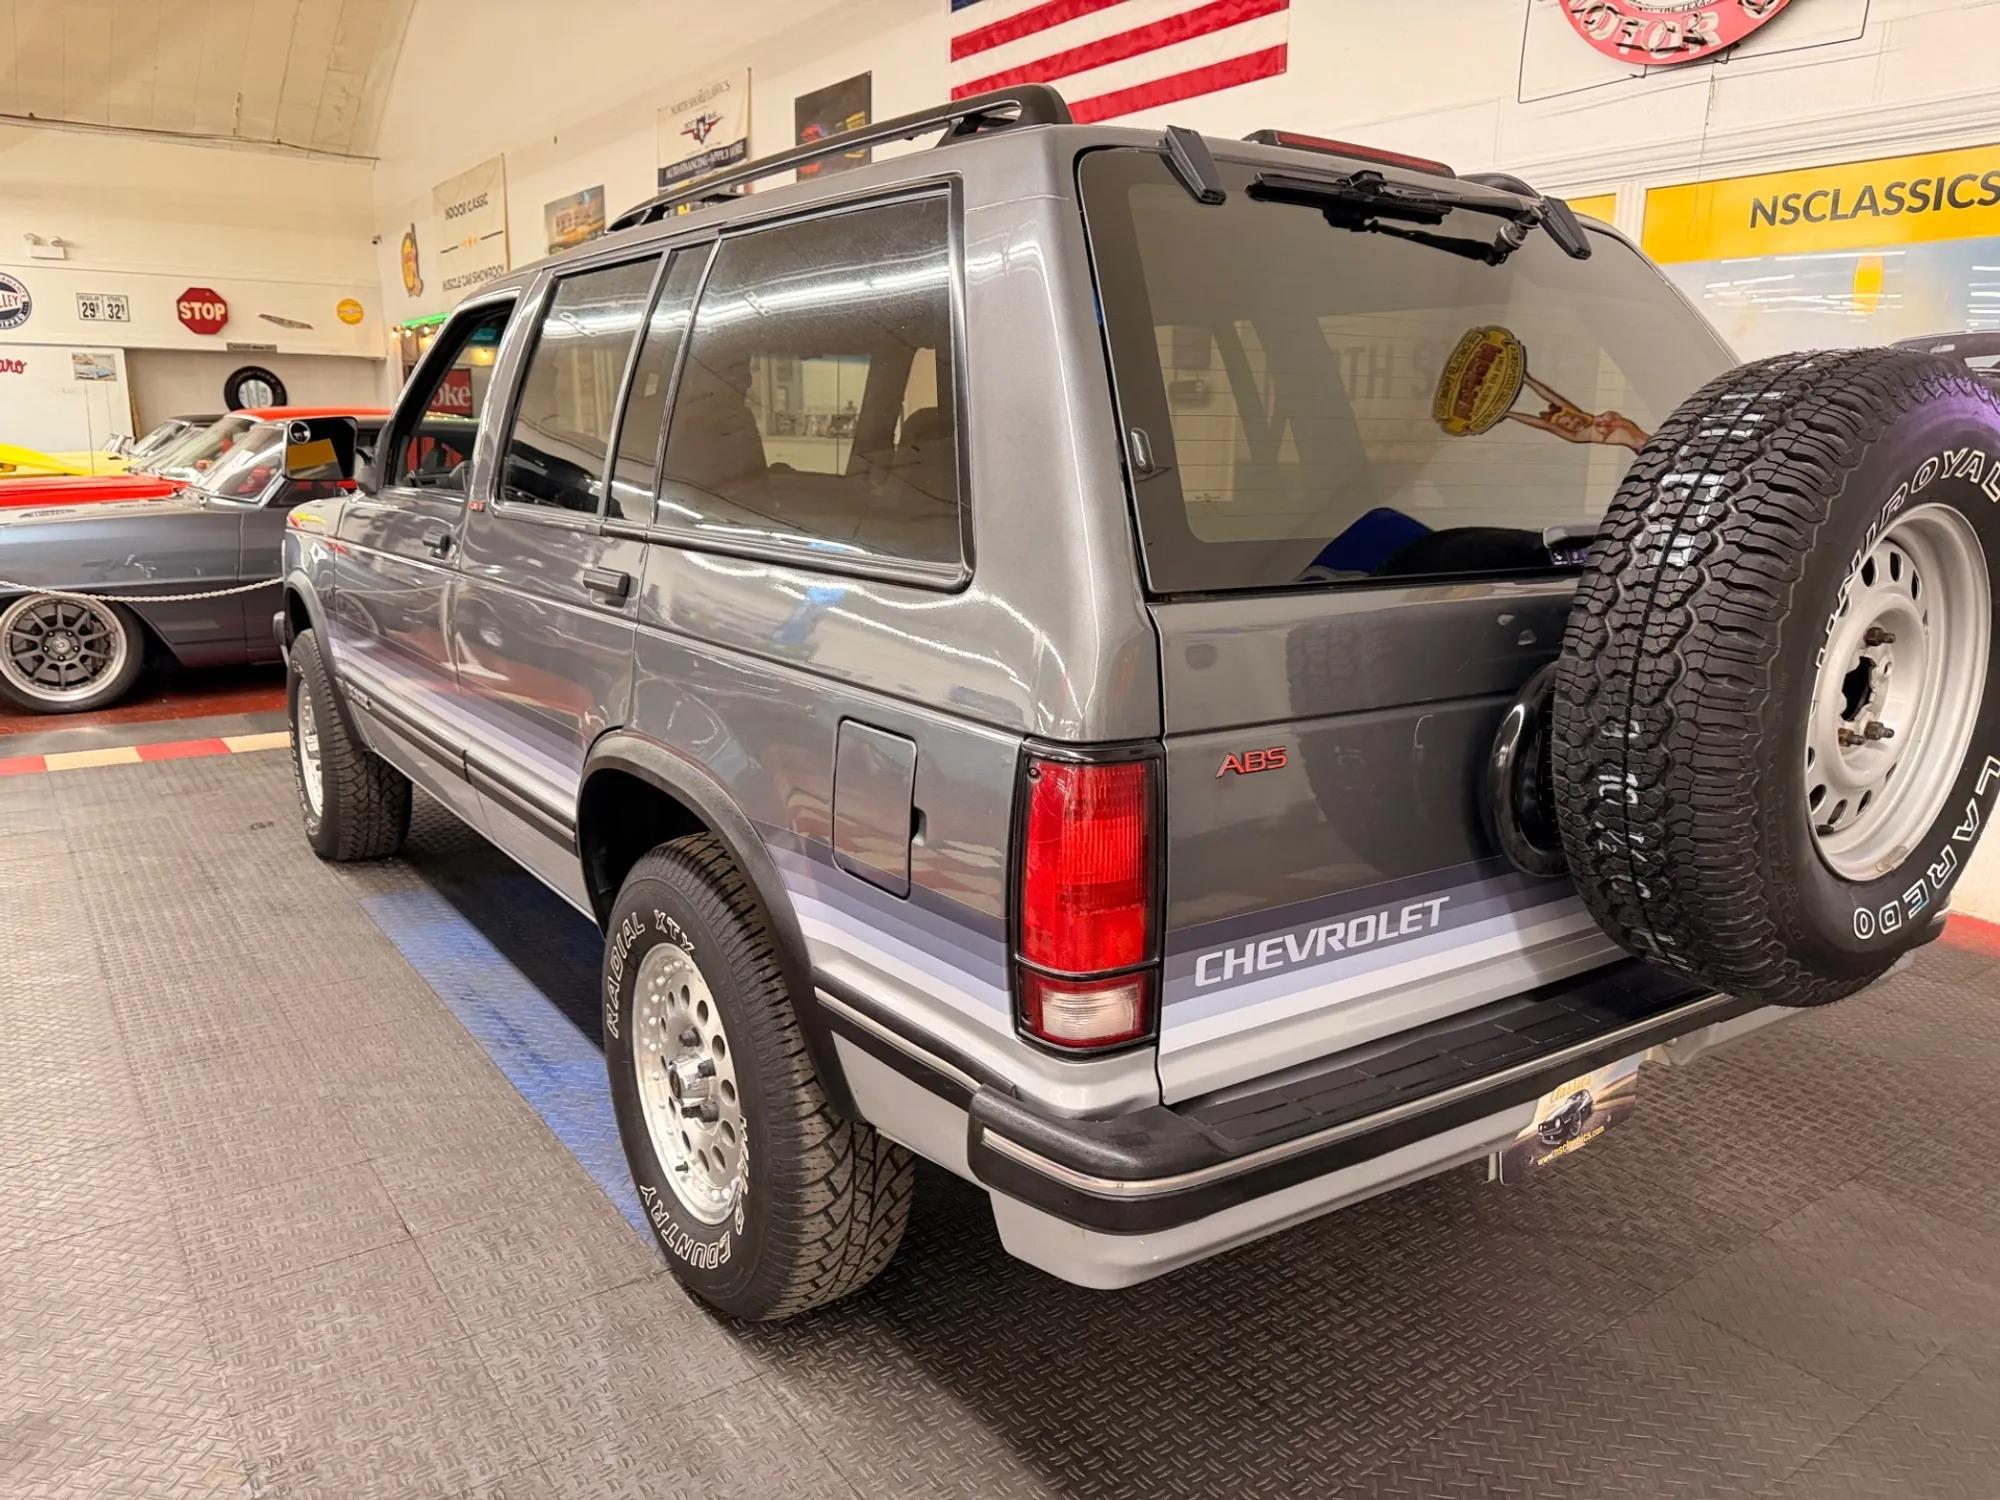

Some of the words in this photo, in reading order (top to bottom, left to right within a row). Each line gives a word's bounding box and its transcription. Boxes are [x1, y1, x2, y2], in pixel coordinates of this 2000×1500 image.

[179, 302, 226, 321] STOP
[432, 383, 472, 407] oke
[1215, 746, 1288, 778] ABS
[1853, 755, 2000, 940] LAREDO
[606, 911, 646, 1039] RADIAL
[1195, 896, 1450, 987] CHEVROLET
[640, 1183, 732, 1269] COUNTRY
